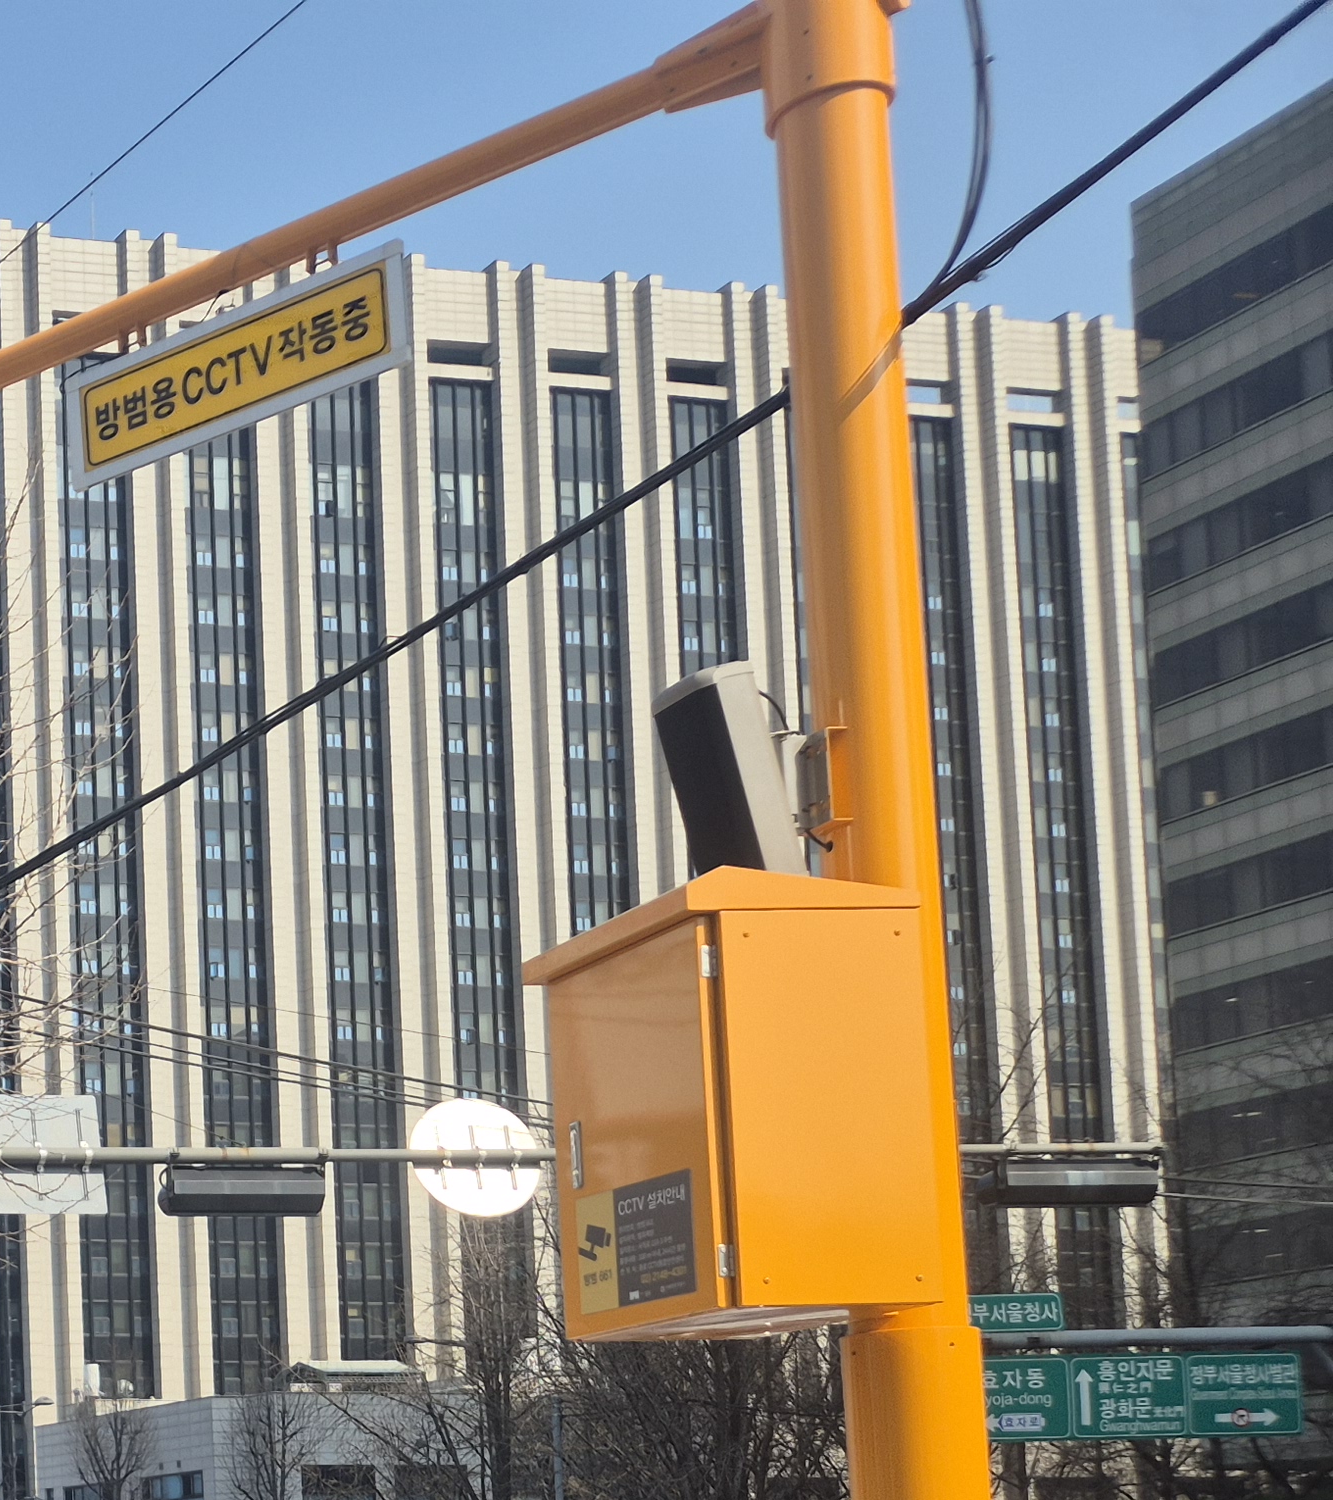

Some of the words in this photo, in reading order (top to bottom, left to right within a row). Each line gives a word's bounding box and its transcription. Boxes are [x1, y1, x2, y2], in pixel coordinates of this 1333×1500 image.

[617, 1195, 646, 1216] CCTV
[967, 1301, 1059, 1324] 부서울청사
[981, 1367, 1046, 1390] 효자동
[1096, 1359, 1175, 1382] 흥인지문
[984, 1392, 1053, 1408] yoja-dong
[1098, 1397, 1153, 1419] 광화문
